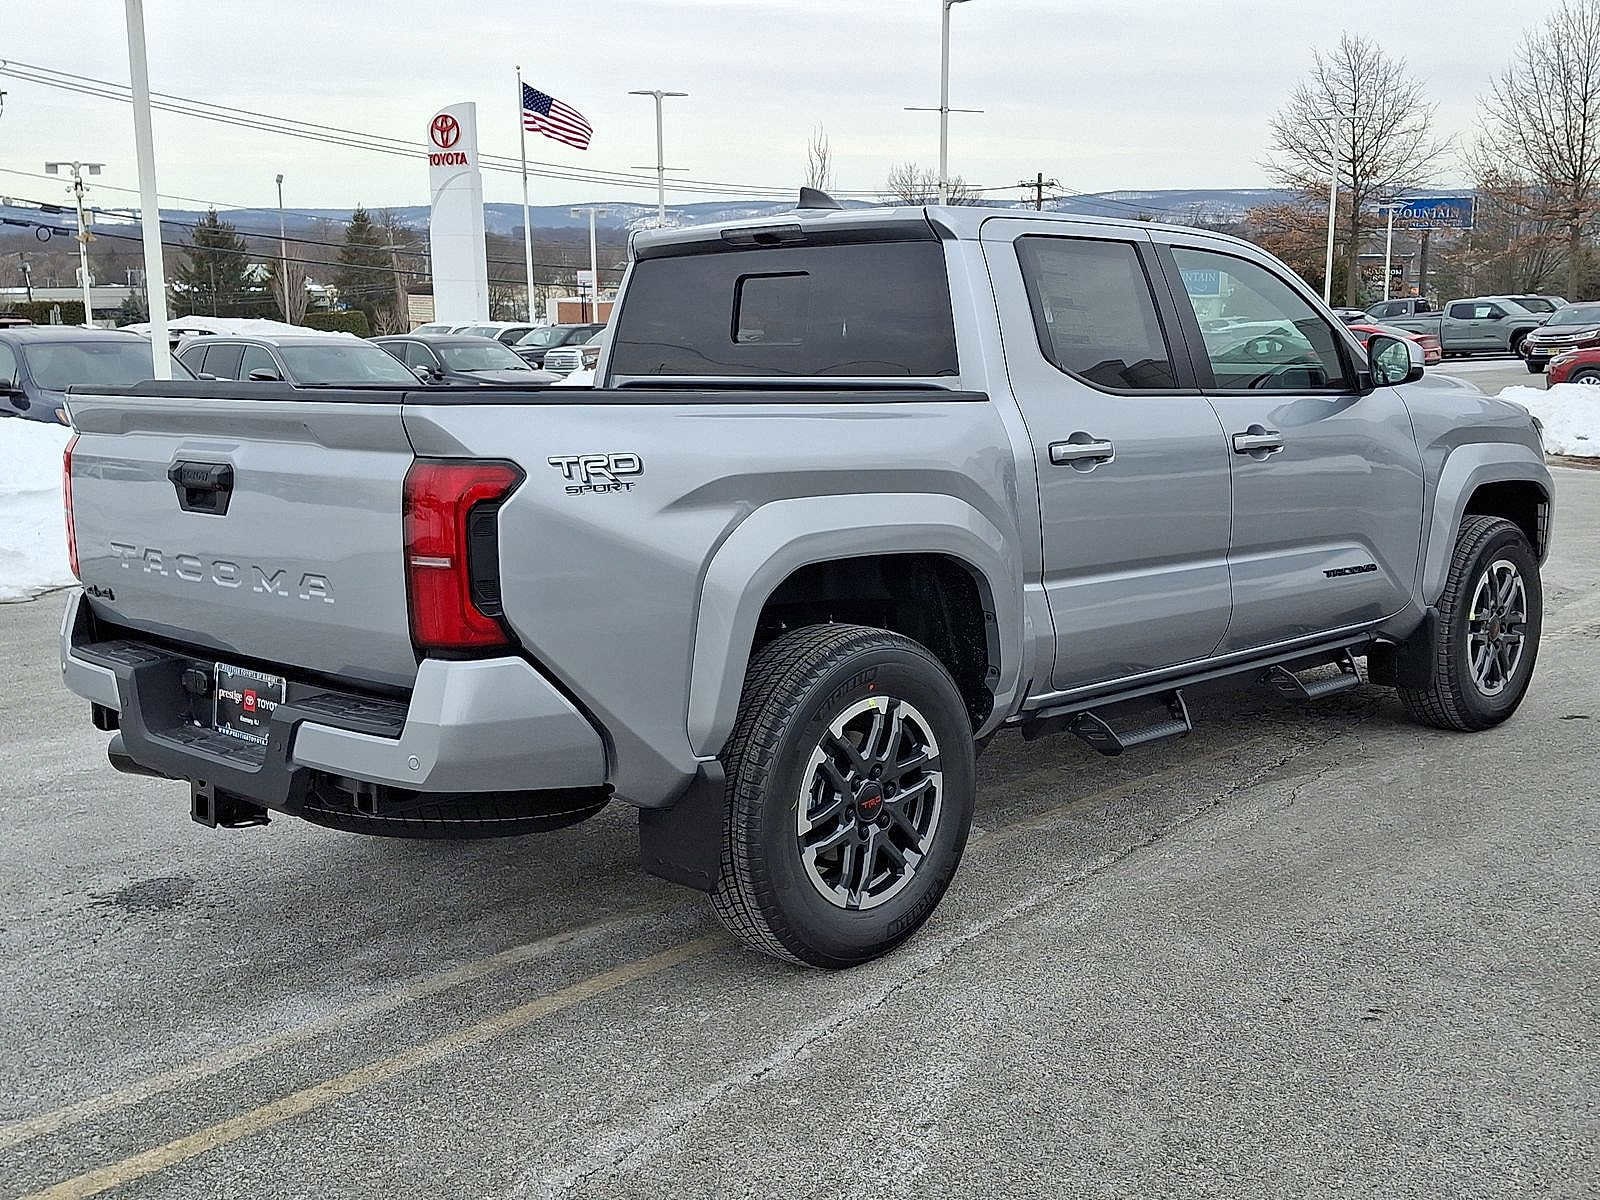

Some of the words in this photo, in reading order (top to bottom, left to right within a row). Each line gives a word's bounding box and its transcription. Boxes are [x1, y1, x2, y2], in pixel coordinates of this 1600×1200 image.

[428, 152, 468, 166] TOYOTA
[548, 453, 645, 483] TRD
[565, 482, 634, 495] SPORT
[110, 542, 335, 603] TACOMA
[218, 688, 243, 704] prestige
[860, 795, 881, 809] TRD
